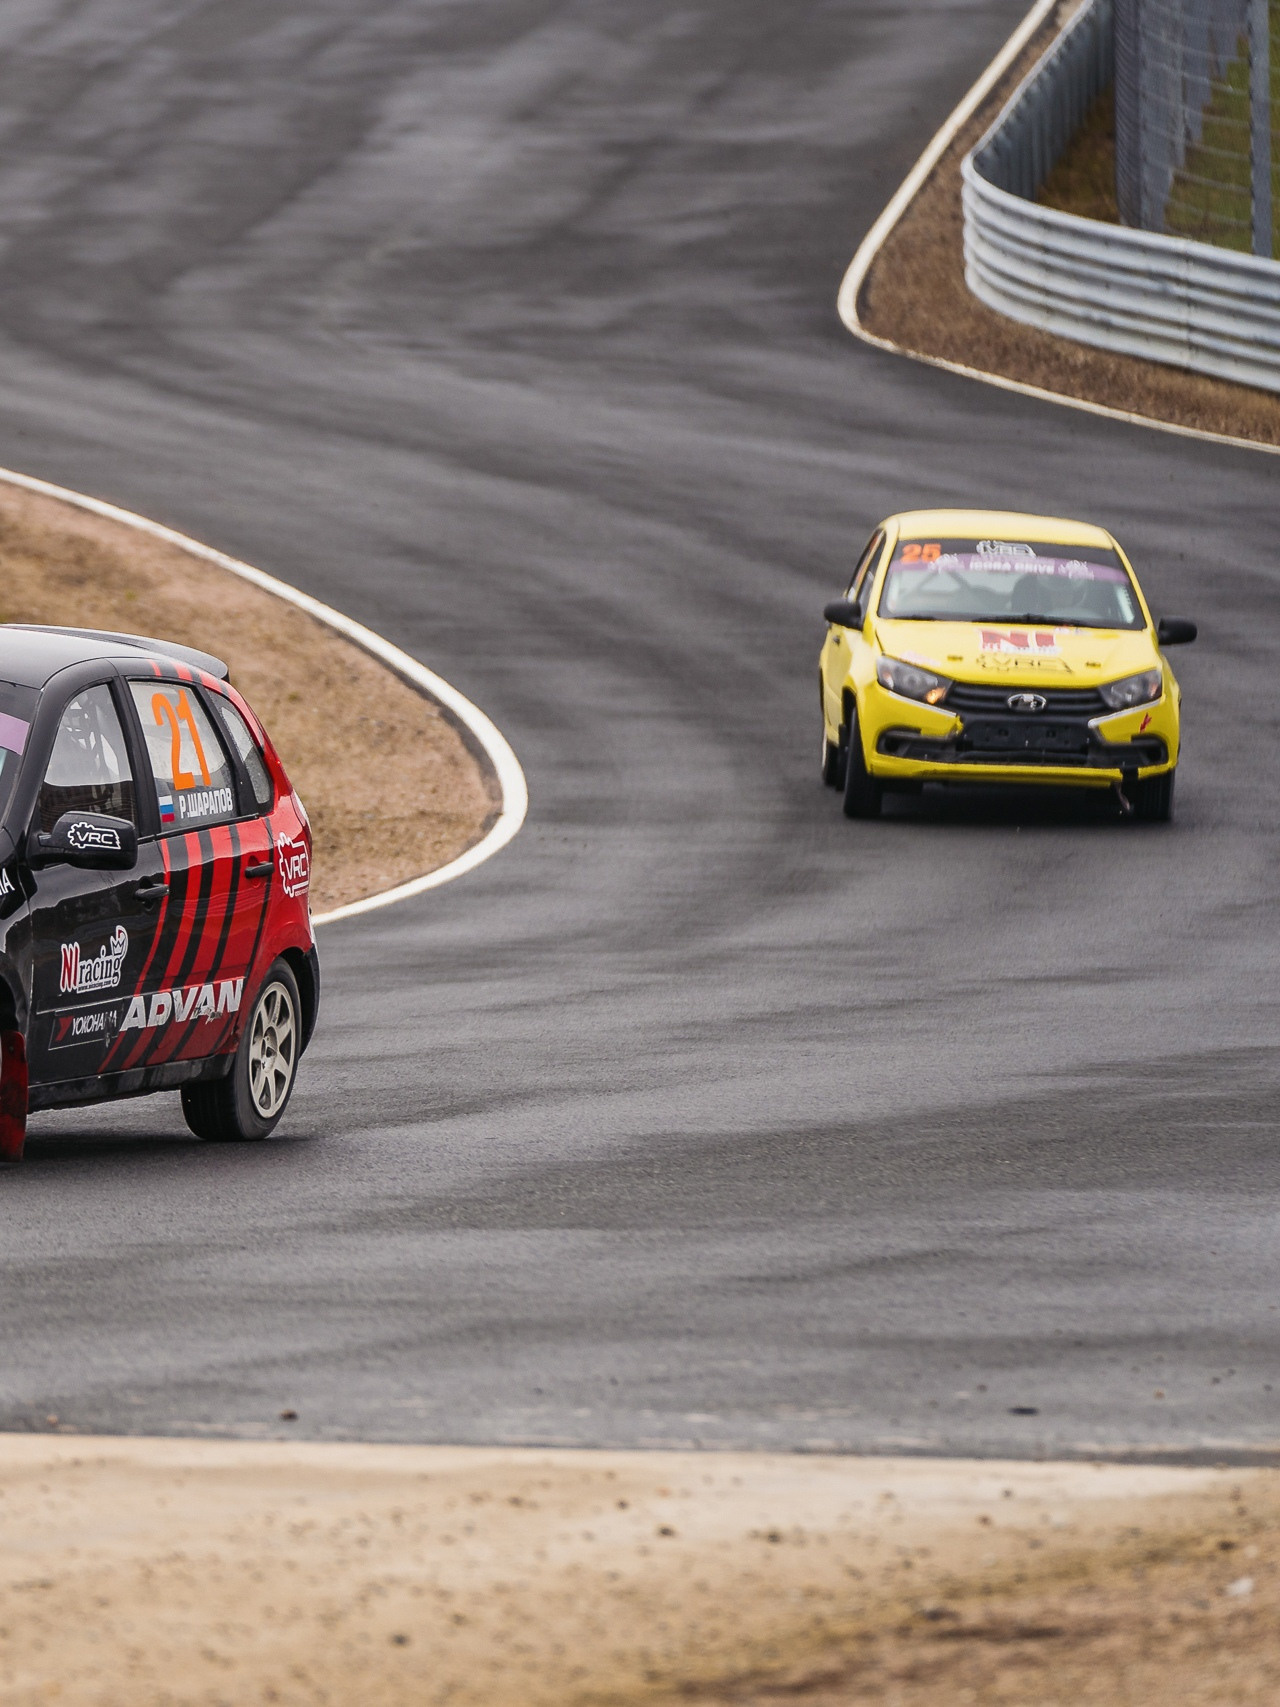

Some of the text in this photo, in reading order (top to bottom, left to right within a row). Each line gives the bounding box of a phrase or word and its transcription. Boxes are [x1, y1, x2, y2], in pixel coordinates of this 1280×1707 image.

[900, 543, 942, 564] 25
[151, 689, 212, 791] 21
[76, 831, 114, 844] VRC
[284, 853, 307, 880] VRC
[119, 978, 245, 1032] ADVAN
